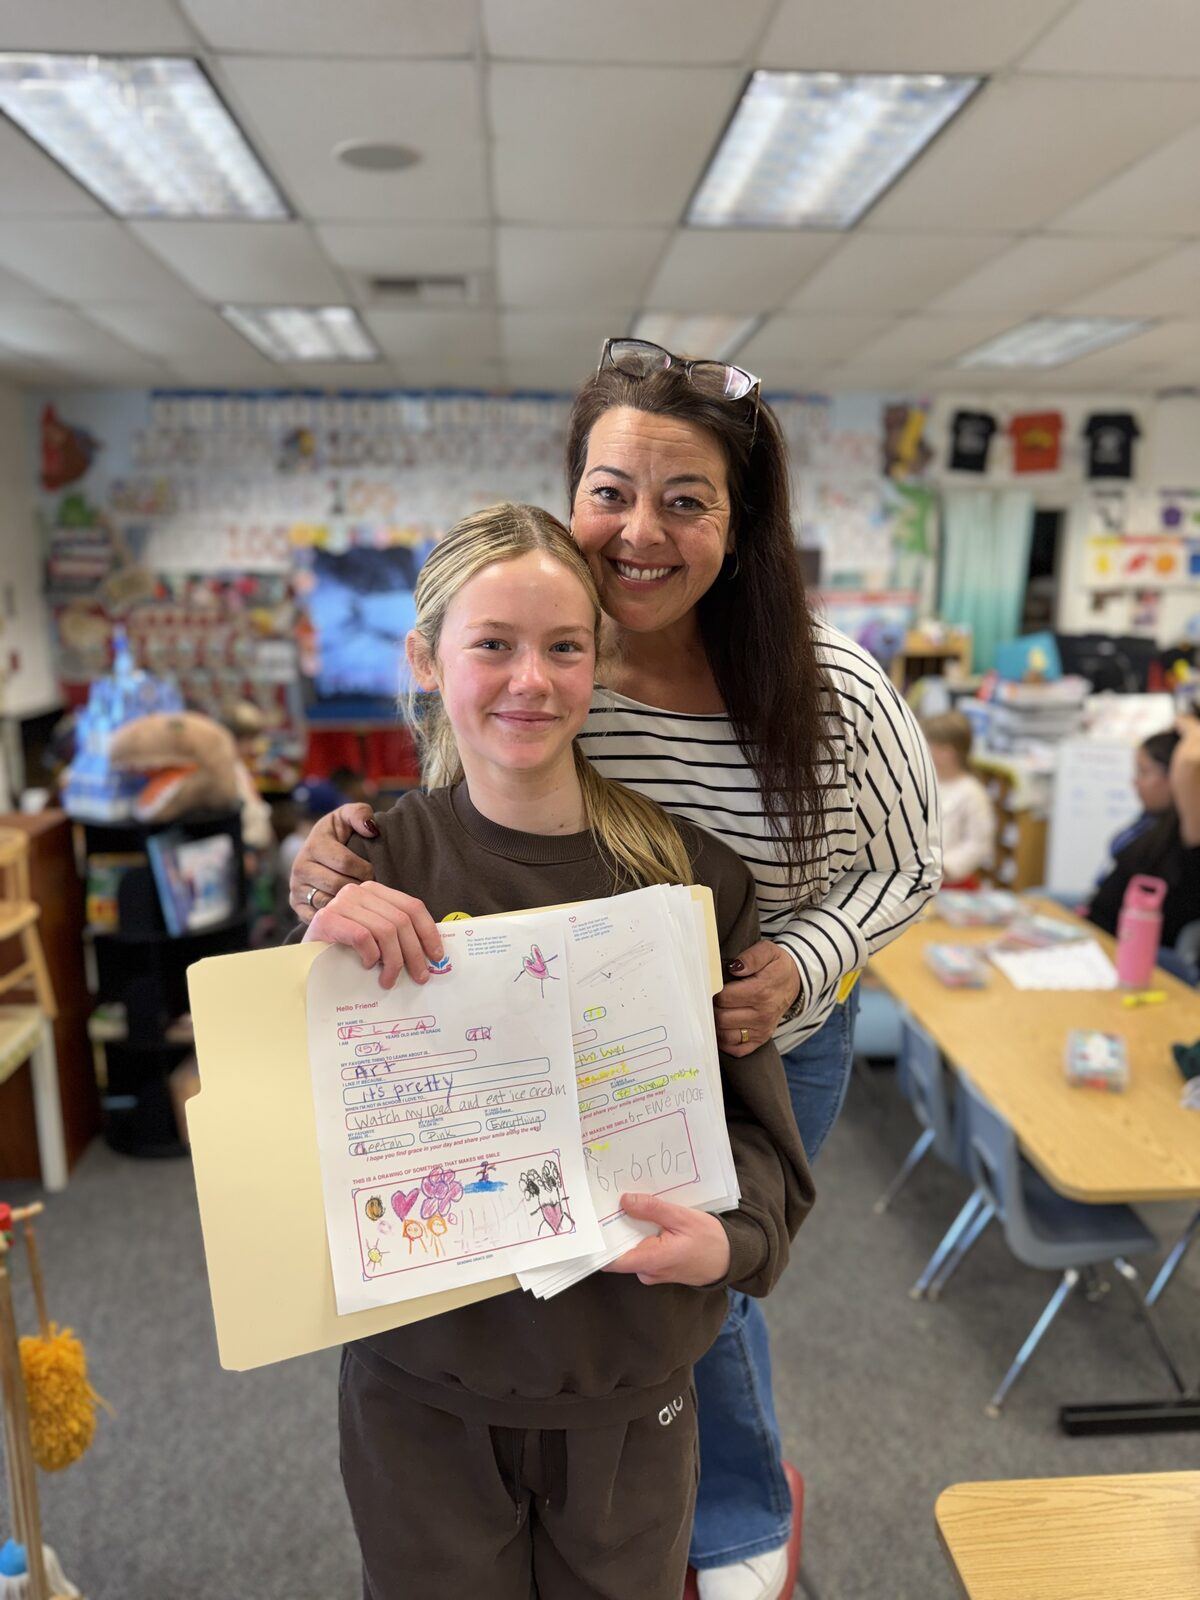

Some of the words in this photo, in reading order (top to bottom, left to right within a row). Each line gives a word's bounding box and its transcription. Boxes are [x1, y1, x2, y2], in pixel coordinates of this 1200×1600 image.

[355, 1002, 379, 1010] Friend!
[355, 1060, 396, 1080] Art
[393, 1073, 453, 1107] pretty
[459, 1094, 480, 1111] and
[486, 1090, 506, 1105] eat
[509, 1088, 526, 1100] ice
[529, 1084, 567, 1098] cream
[427, 1128, 456, 1142] Pink
[589, 1126, 606, 1135] MAKES
[370, 1154, 384, 1162] hope
[408, 1148, 424, 1156] grace
[430, 1144, 442, 1152] your
[480, 1134, 492, 1142] your
[378, 1171, 404, 1180] DRAWING
[412, 1163, 444, 1174] SOMETHING
[458, 1156, 476, 1164] MAKES
